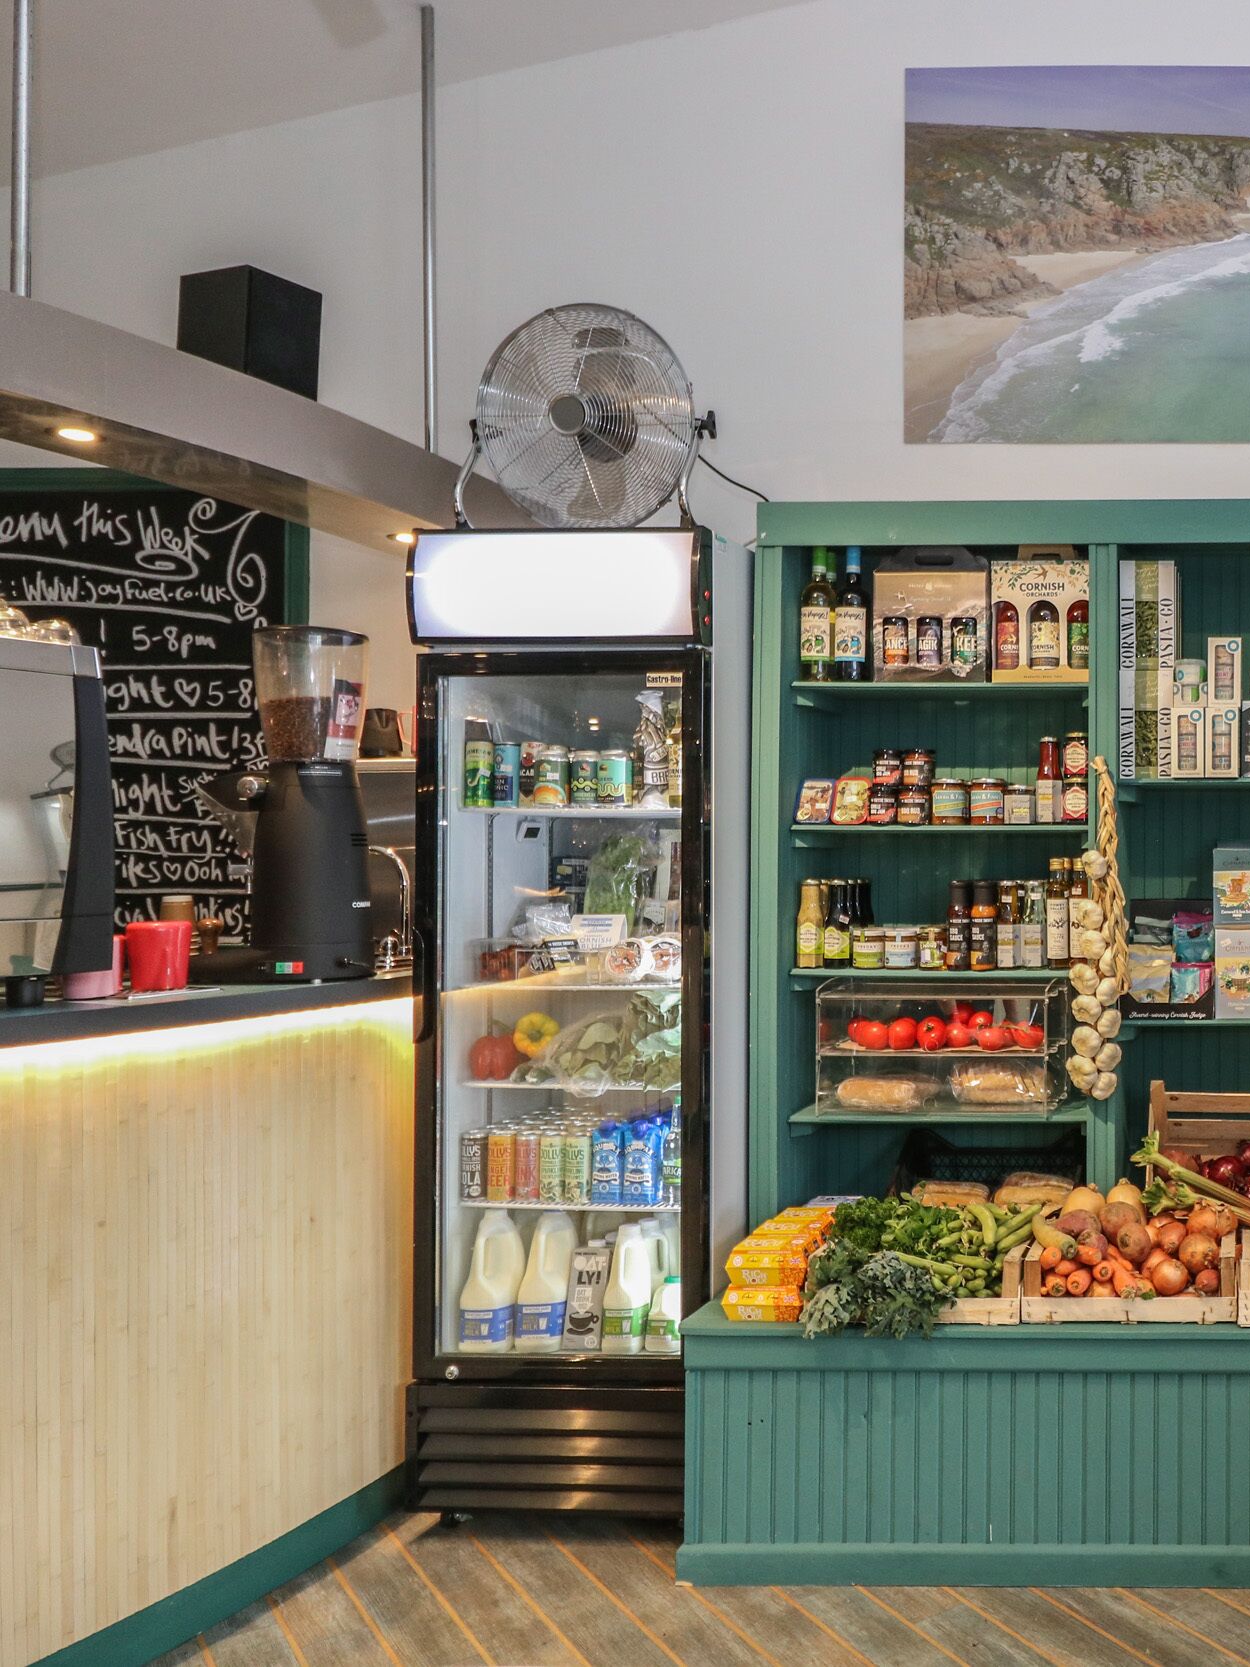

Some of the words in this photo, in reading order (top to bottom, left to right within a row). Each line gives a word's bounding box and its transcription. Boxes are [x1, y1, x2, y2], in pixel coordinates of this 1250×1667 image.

[1019, 582, 1065, 592] CORNISH
[132, 625, 217, 659] 5-8pm
[1121, 598, 1134, 669] CORNWALL
[1160, 627, 1173, 668] PASTA
[1120, 707, 1134, 778] CORNWALL
[1159, 735, 1172, 778] PASTA
[576, 1270, 601, 1285] LY!
